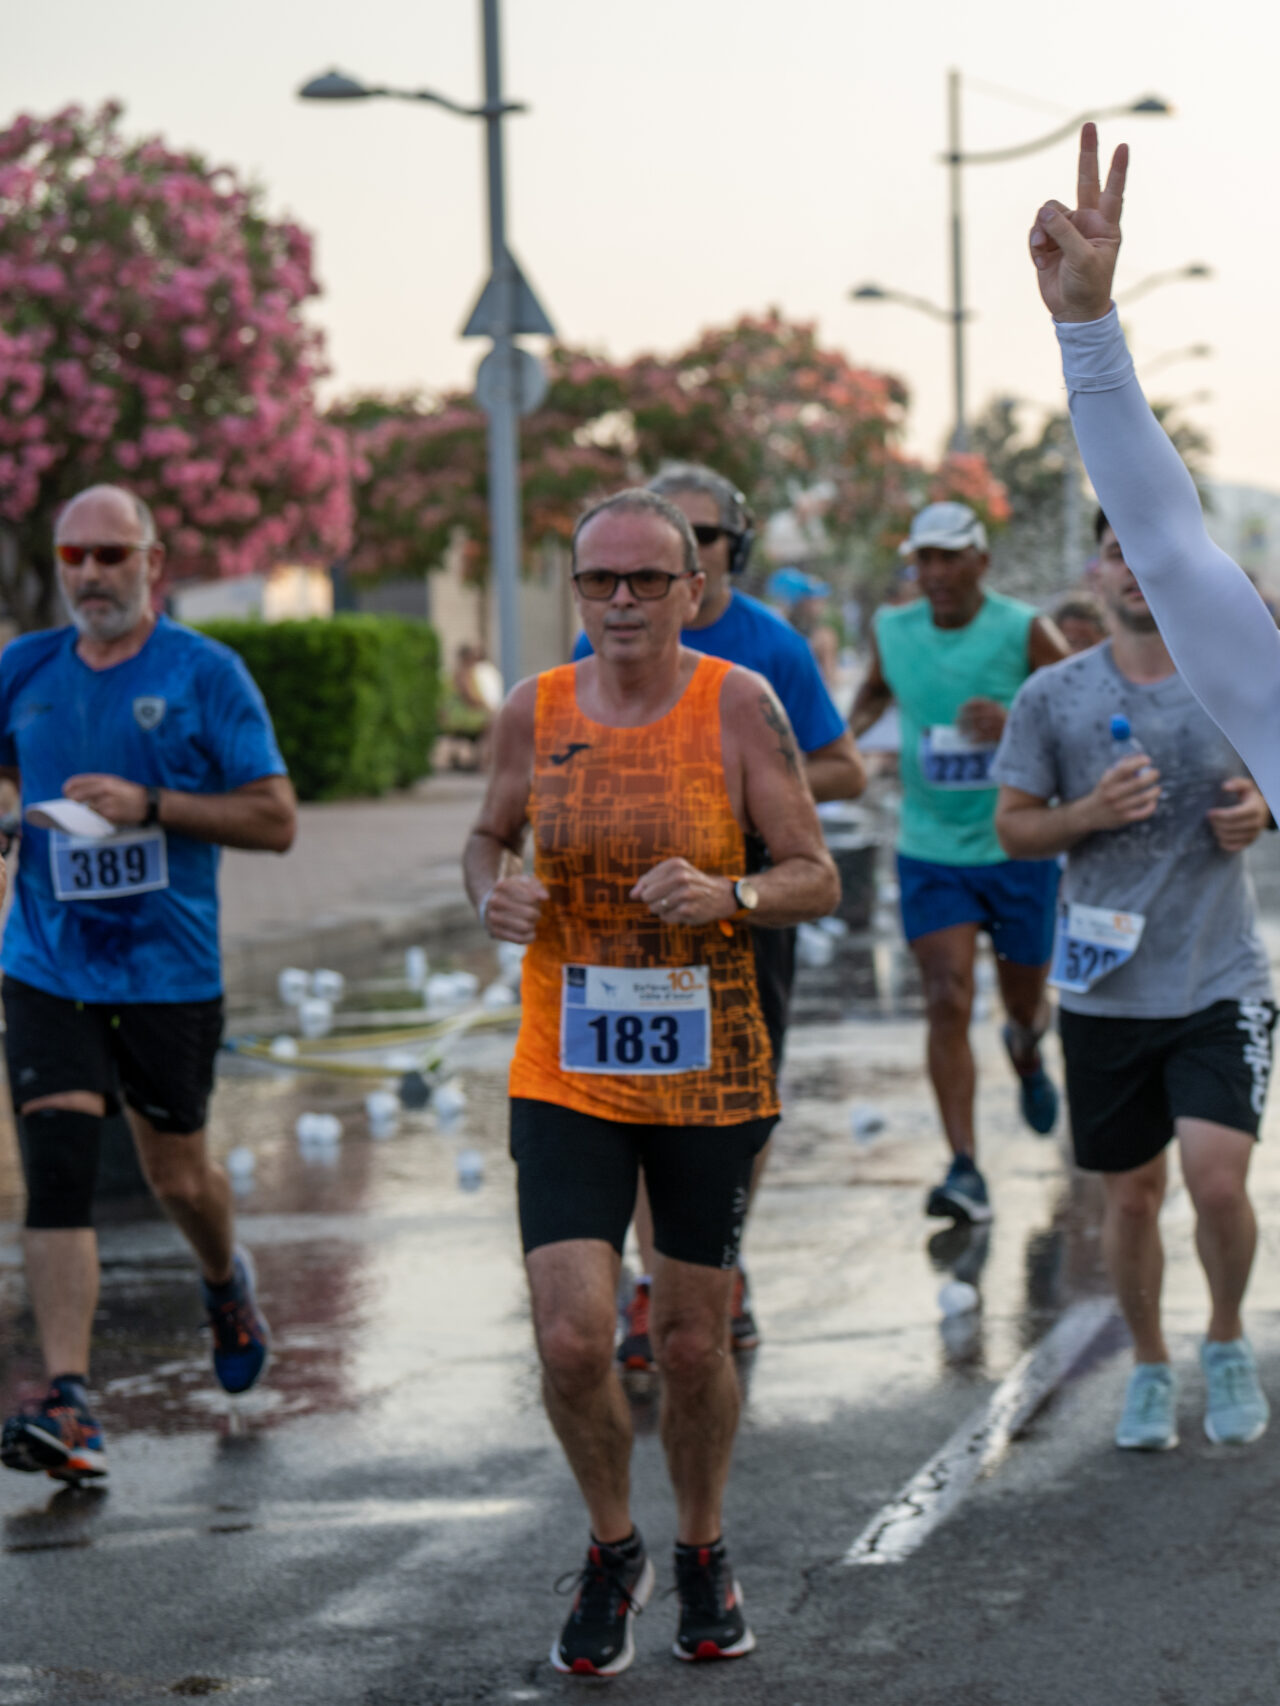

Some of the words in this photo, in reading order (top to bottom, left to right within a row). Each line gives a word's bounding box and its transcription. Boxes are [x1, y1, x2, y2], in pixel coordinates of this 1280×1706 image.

[71, 844, 147, 890] 389
[667, 970, 694, 992] 10
[588, 1014, 679, 1065] 183
